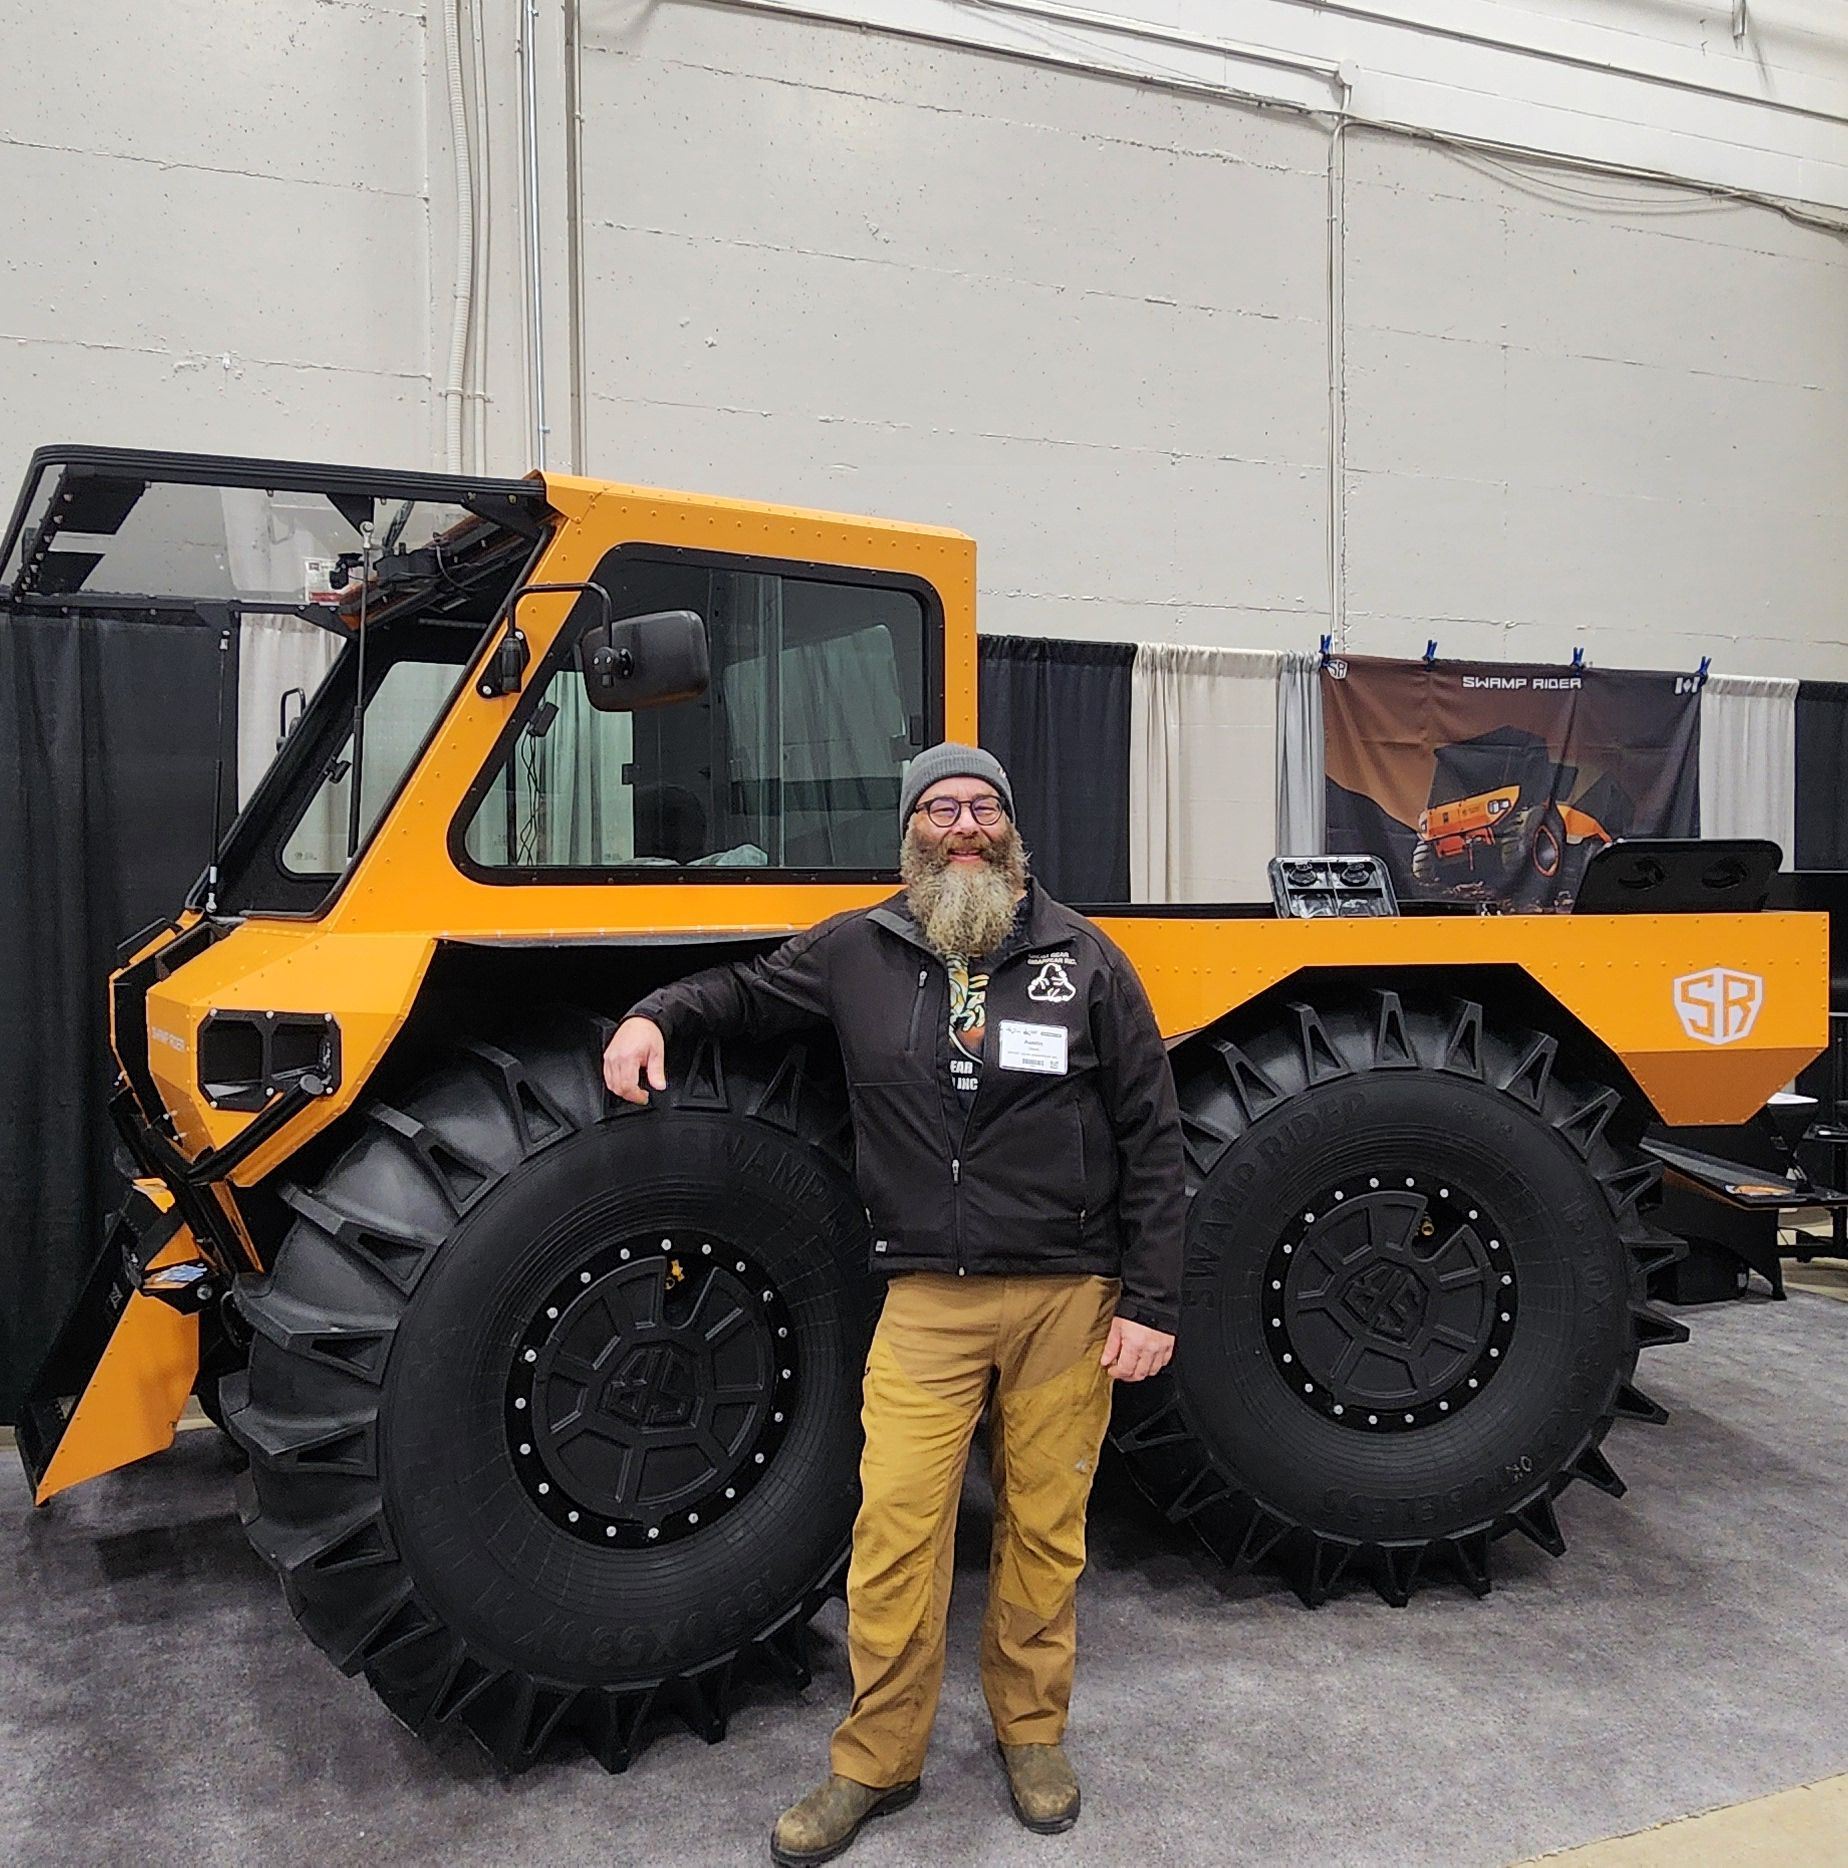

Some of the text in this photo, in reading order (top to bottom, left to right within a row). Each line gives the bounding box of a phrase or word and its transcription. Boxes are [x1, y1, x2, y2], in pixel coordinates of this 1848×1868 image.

[1462, 676, 1581, 690] SWAMP RIDER
[1681, 973, 1755, 1037] SR
[950, 1060, 973, 1074] EAR
[957, 1077, 978, 1090] INC
